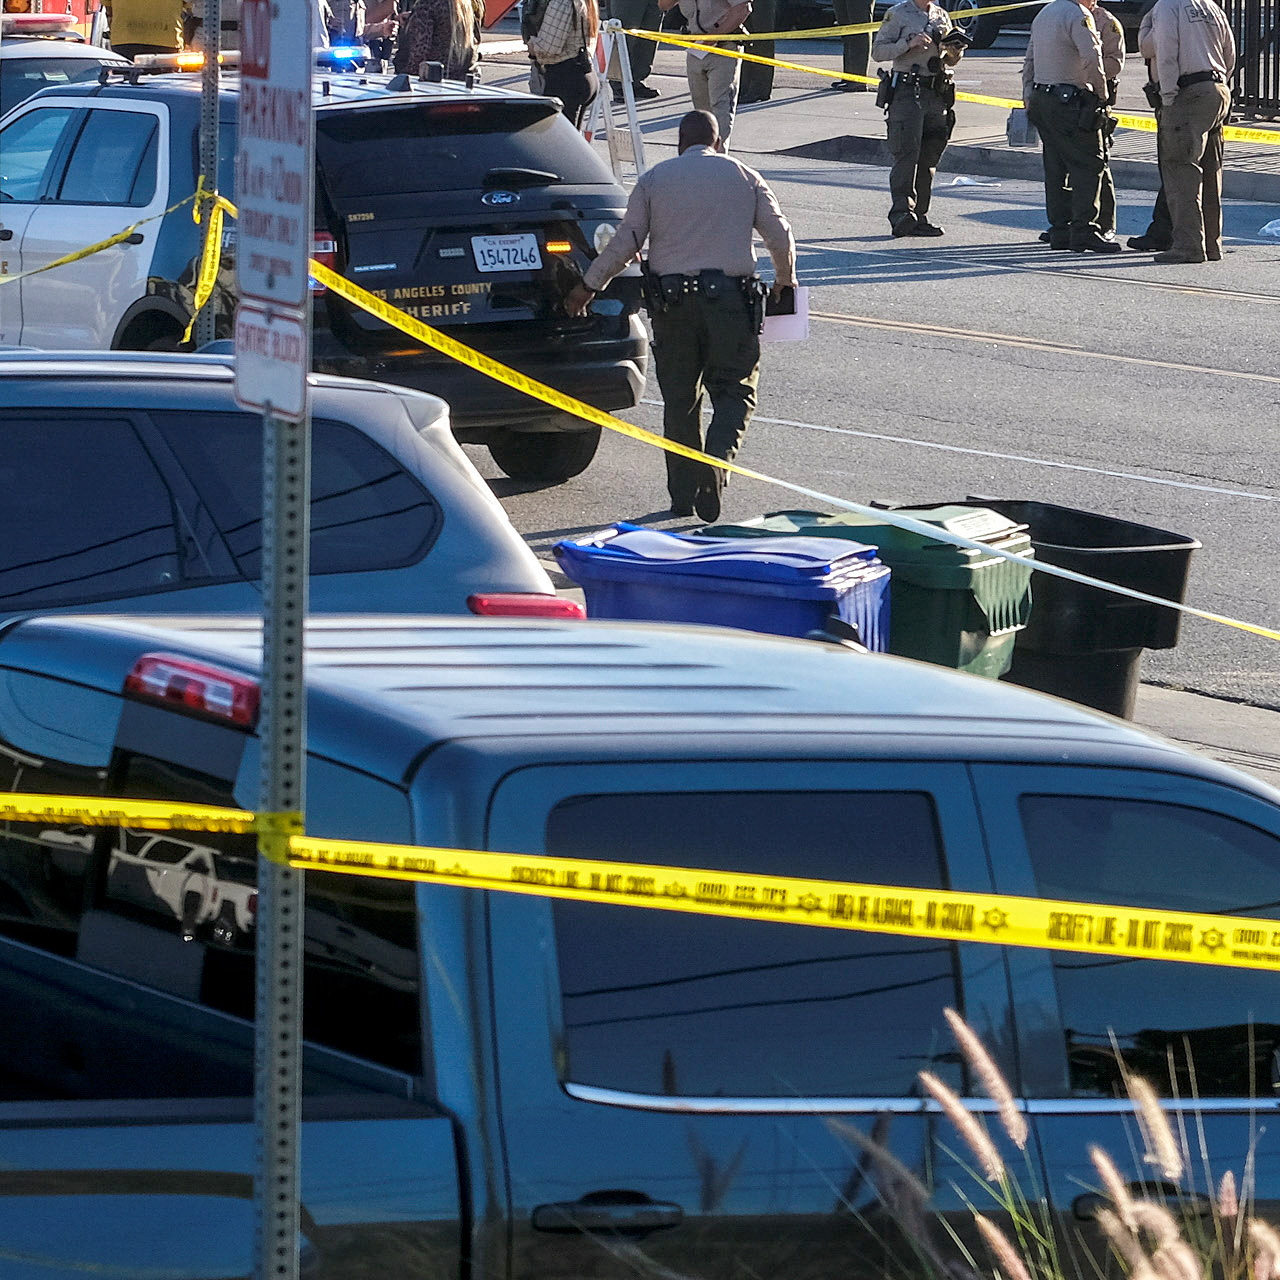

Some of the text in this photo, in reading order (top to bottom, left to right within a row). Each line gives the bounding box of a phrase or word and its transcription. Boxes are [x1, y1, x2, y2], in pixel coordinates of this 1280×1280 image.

[241, 82, 308, 147] PARKING
[491, 194, 513, 204] Ford
[480, 247, 537, 266] 1547246
[371, 282, 493, 301] OS ANGELES COUNTY
[401, 303, 472, 318] HERIFF
